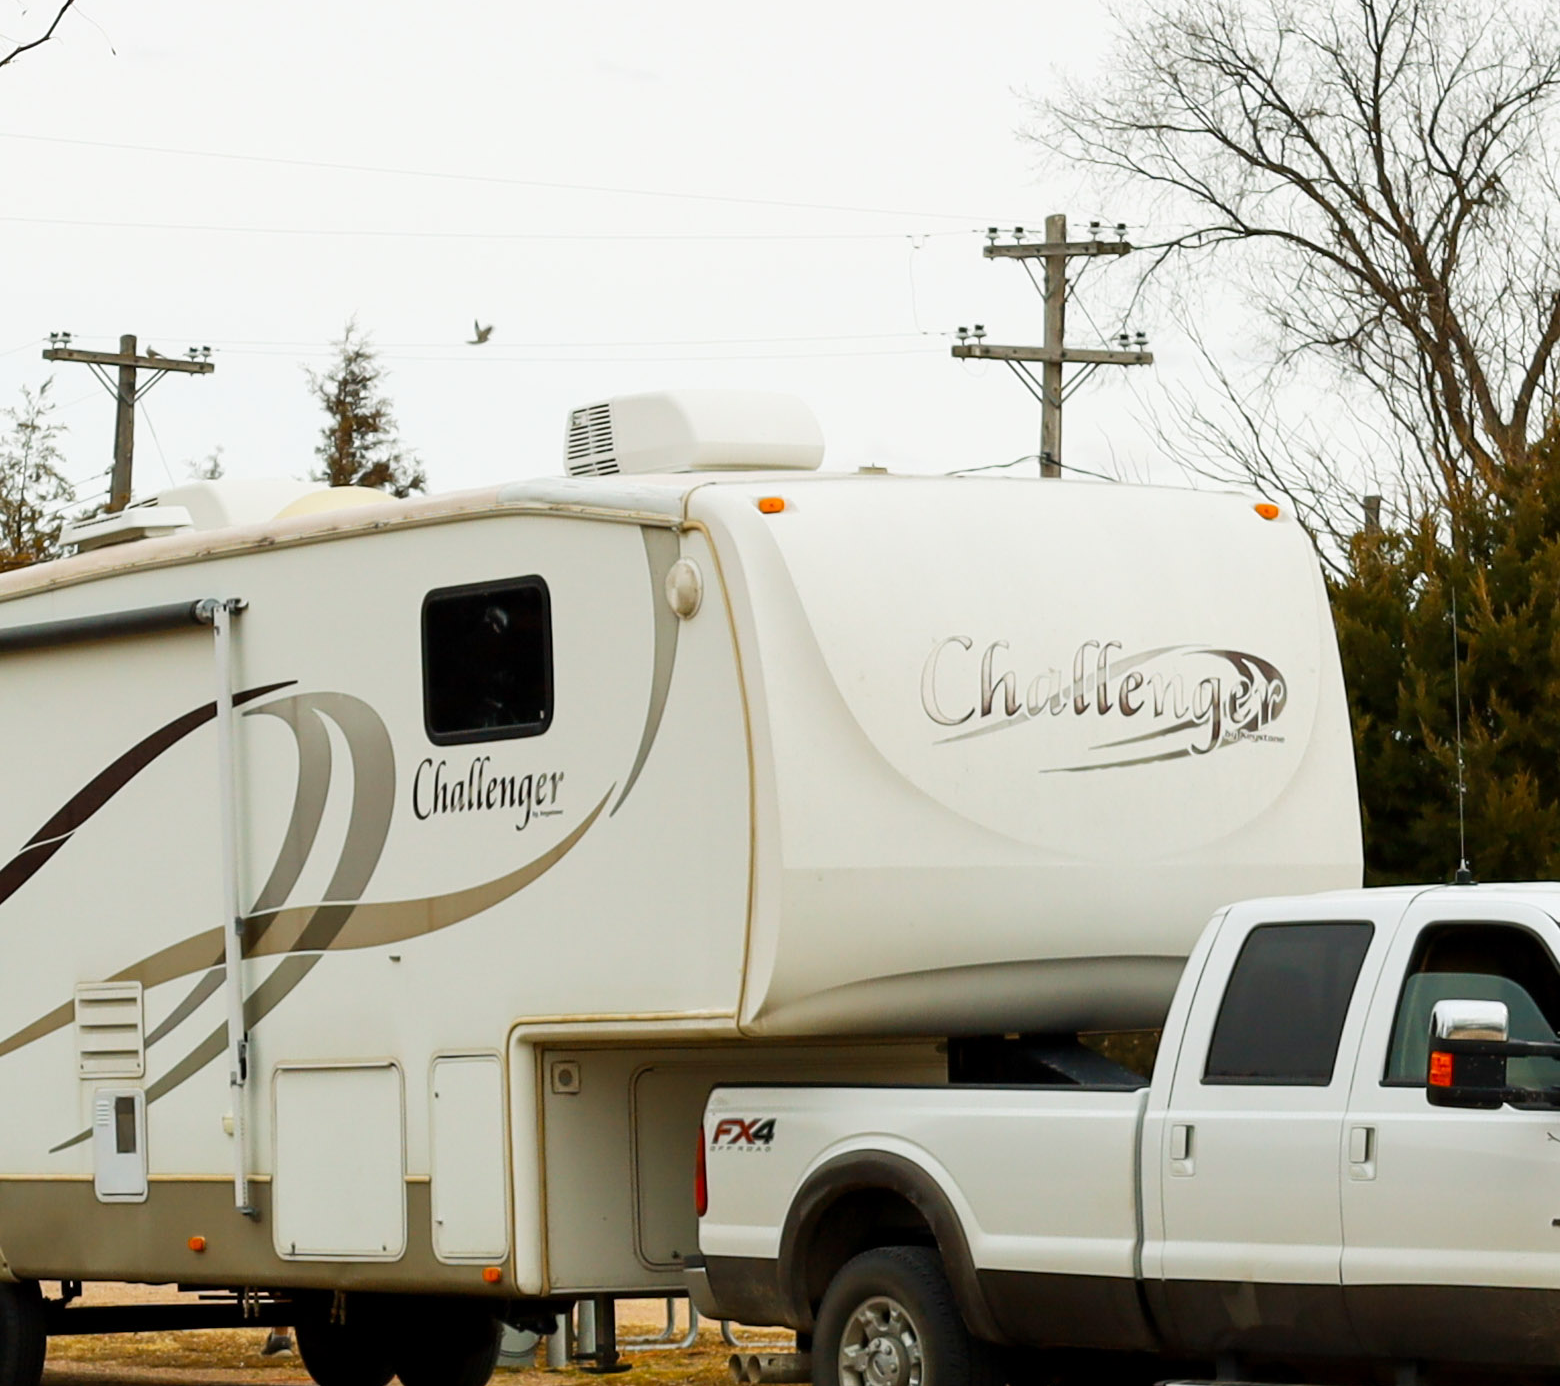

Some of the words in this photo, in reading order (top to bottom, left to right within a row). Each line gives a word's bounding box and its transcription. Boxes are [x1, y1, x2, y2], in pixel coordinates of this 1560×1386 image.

[920, 634, 1285, 755] Challenger
[413, 756, 564, 831] Challenger
[711, 1118, 777, 1144] FX4
[737, 1145, 771, 1153] ROAD
